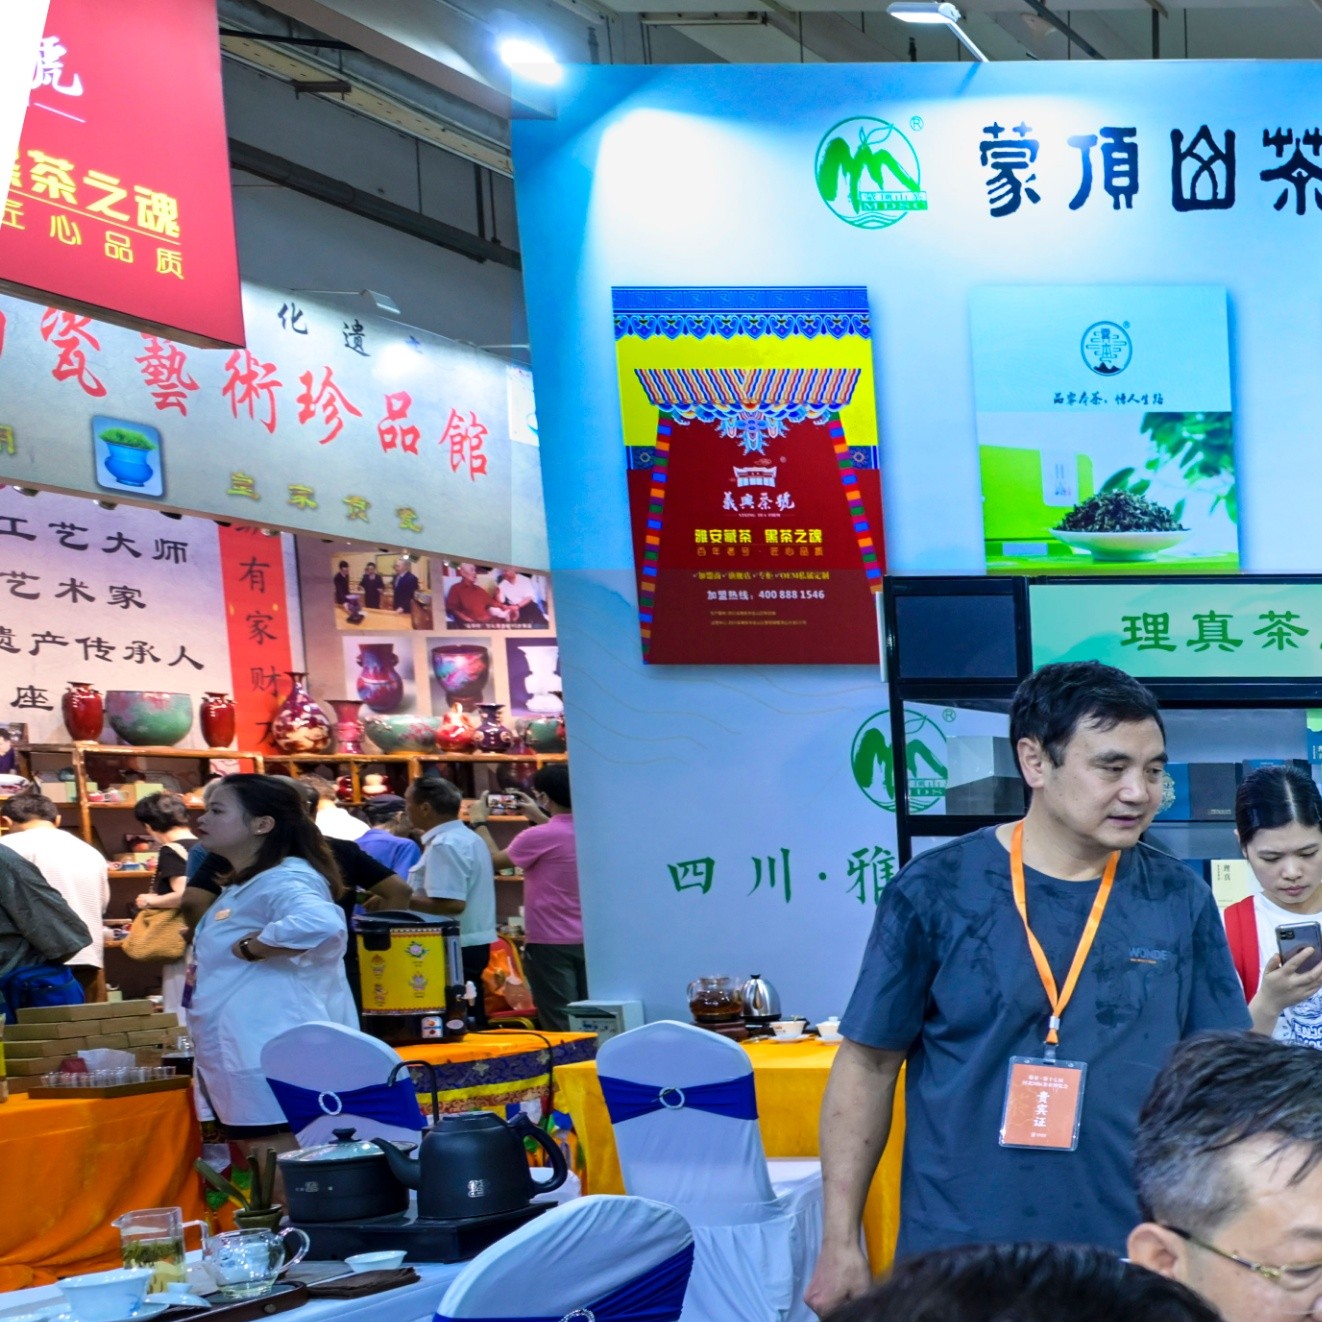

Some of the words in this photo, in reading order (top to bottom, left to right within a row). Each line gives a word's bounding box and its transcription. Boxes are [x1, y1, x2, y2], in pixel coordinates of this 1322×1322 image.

[0, 305, 488, 481] 瓷藝術珍品館
[0, 516, 188, 564] 工艺大师
[764, 529, 823, 543] 黑茶之魂
[0, 571, 147, 609] 艺术家
[758, 591, 777, 599] 400
[779, 591, 798, 599] 888
[800, 591, 825, 599] 1546
[10, 685, 54, 711] 座
